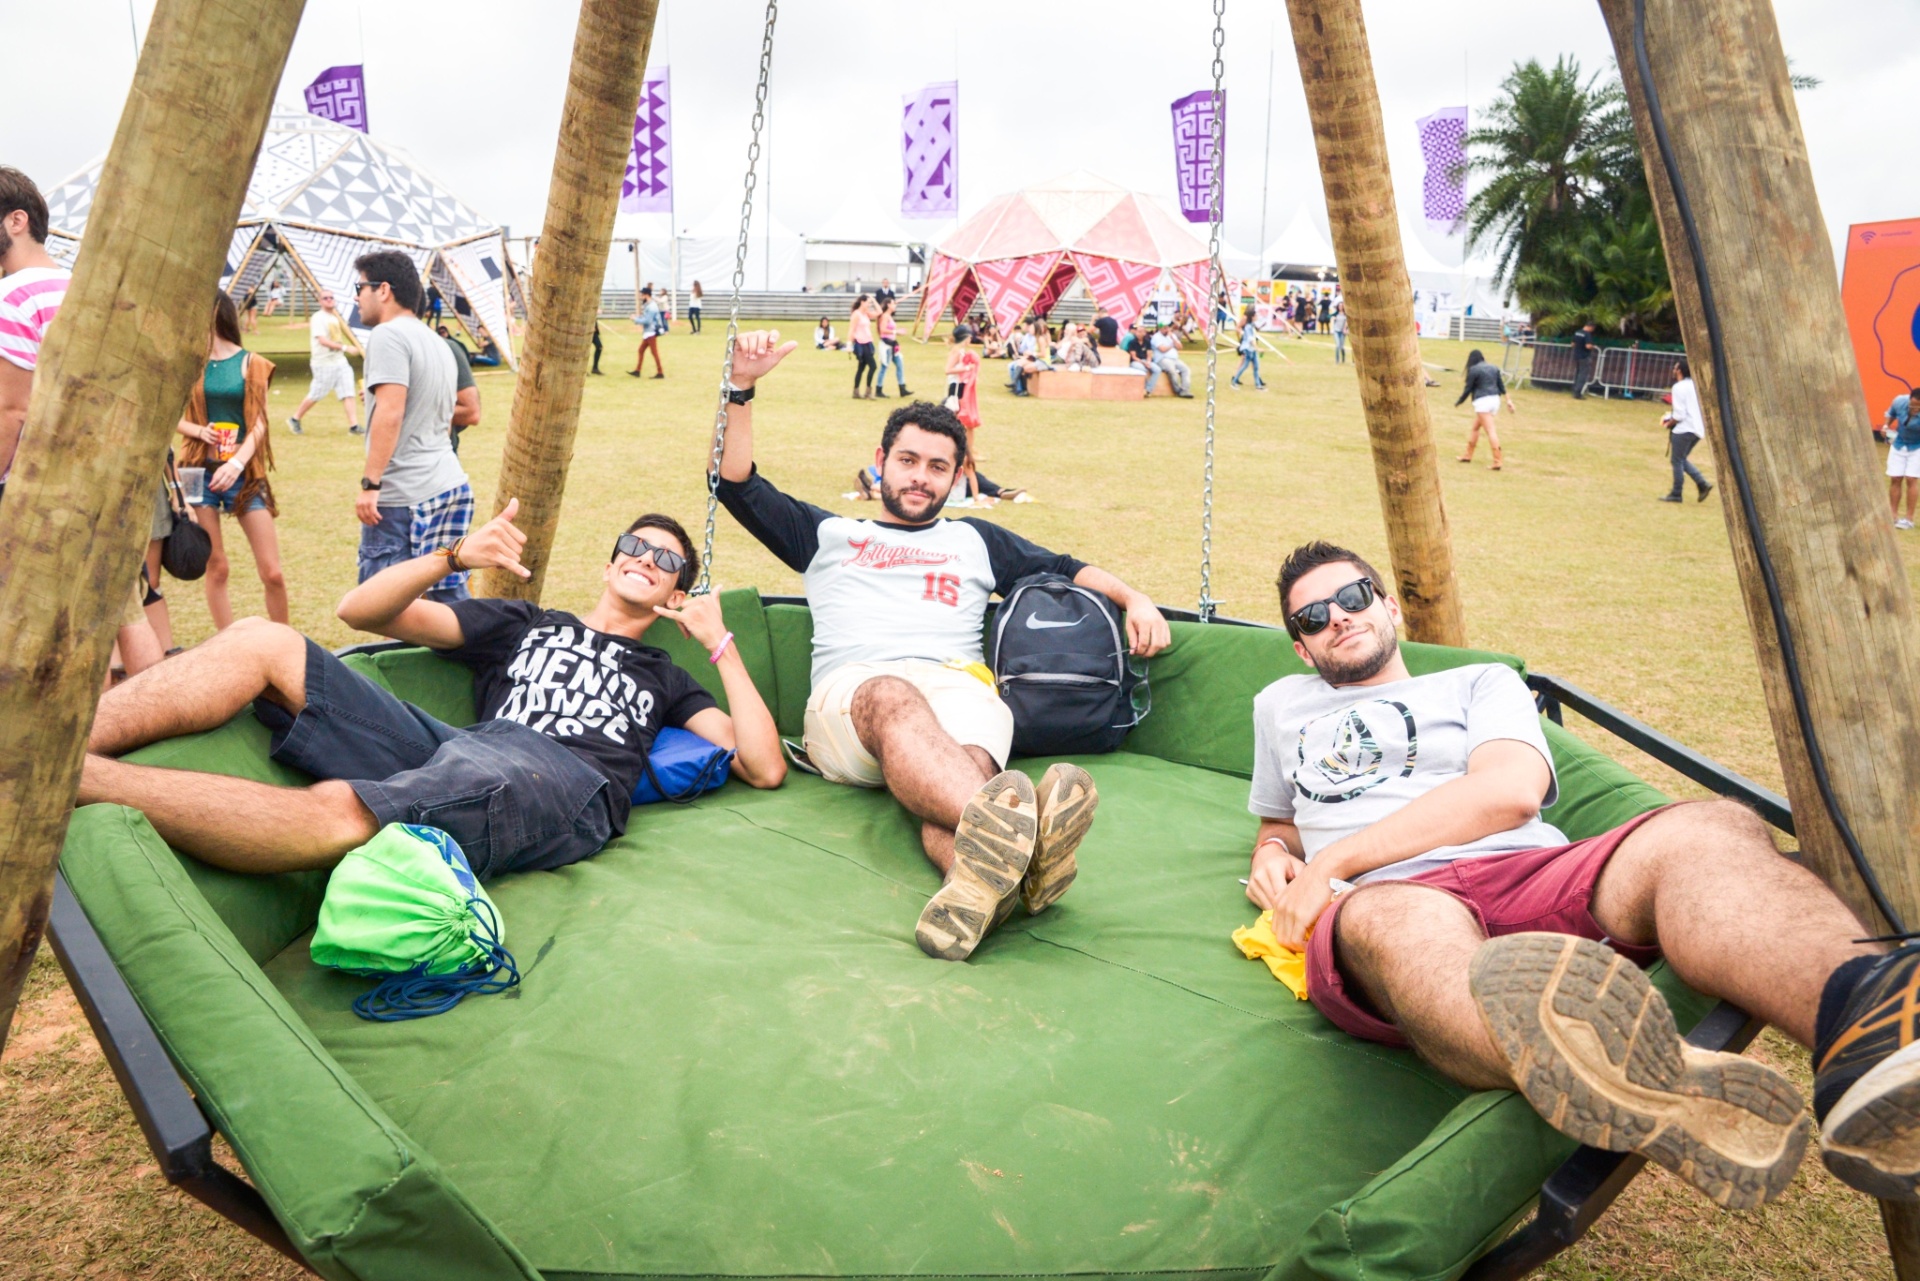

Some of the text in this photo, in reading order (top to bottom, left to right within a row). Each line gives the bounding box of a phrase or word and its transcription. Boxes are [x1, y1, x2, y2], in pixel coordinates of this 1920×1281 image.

[921, 571, 961, 608] 16
[495, 682, 630, 745] DANCE
[507, 647, 654, 727] MENOS
